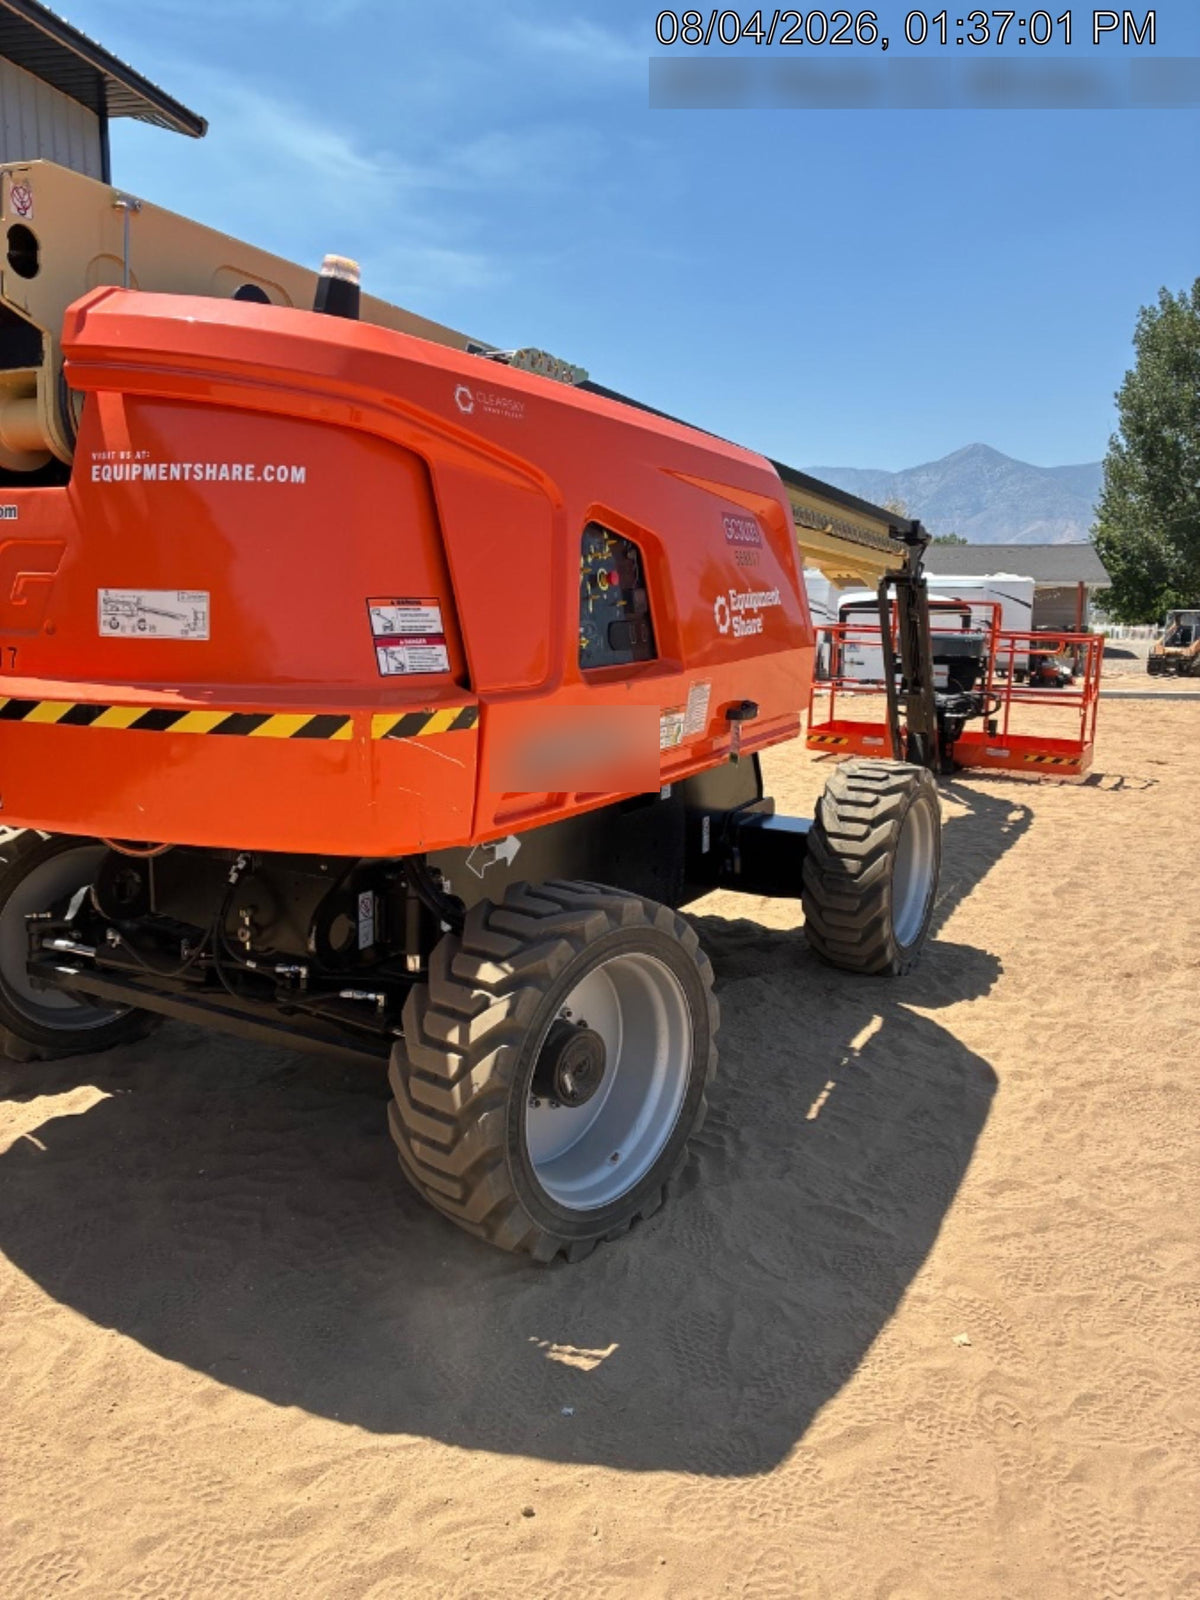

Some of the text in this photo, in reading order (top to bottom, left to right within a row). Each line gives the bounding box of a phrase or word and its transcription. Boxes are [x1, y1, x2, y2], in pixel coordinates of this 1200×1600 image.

[91, 463, 306, 484] EQUIPMENTSHARE.COM
[729, 588, 782, 615] Equipment
[732, 615, 763, 638] Share
